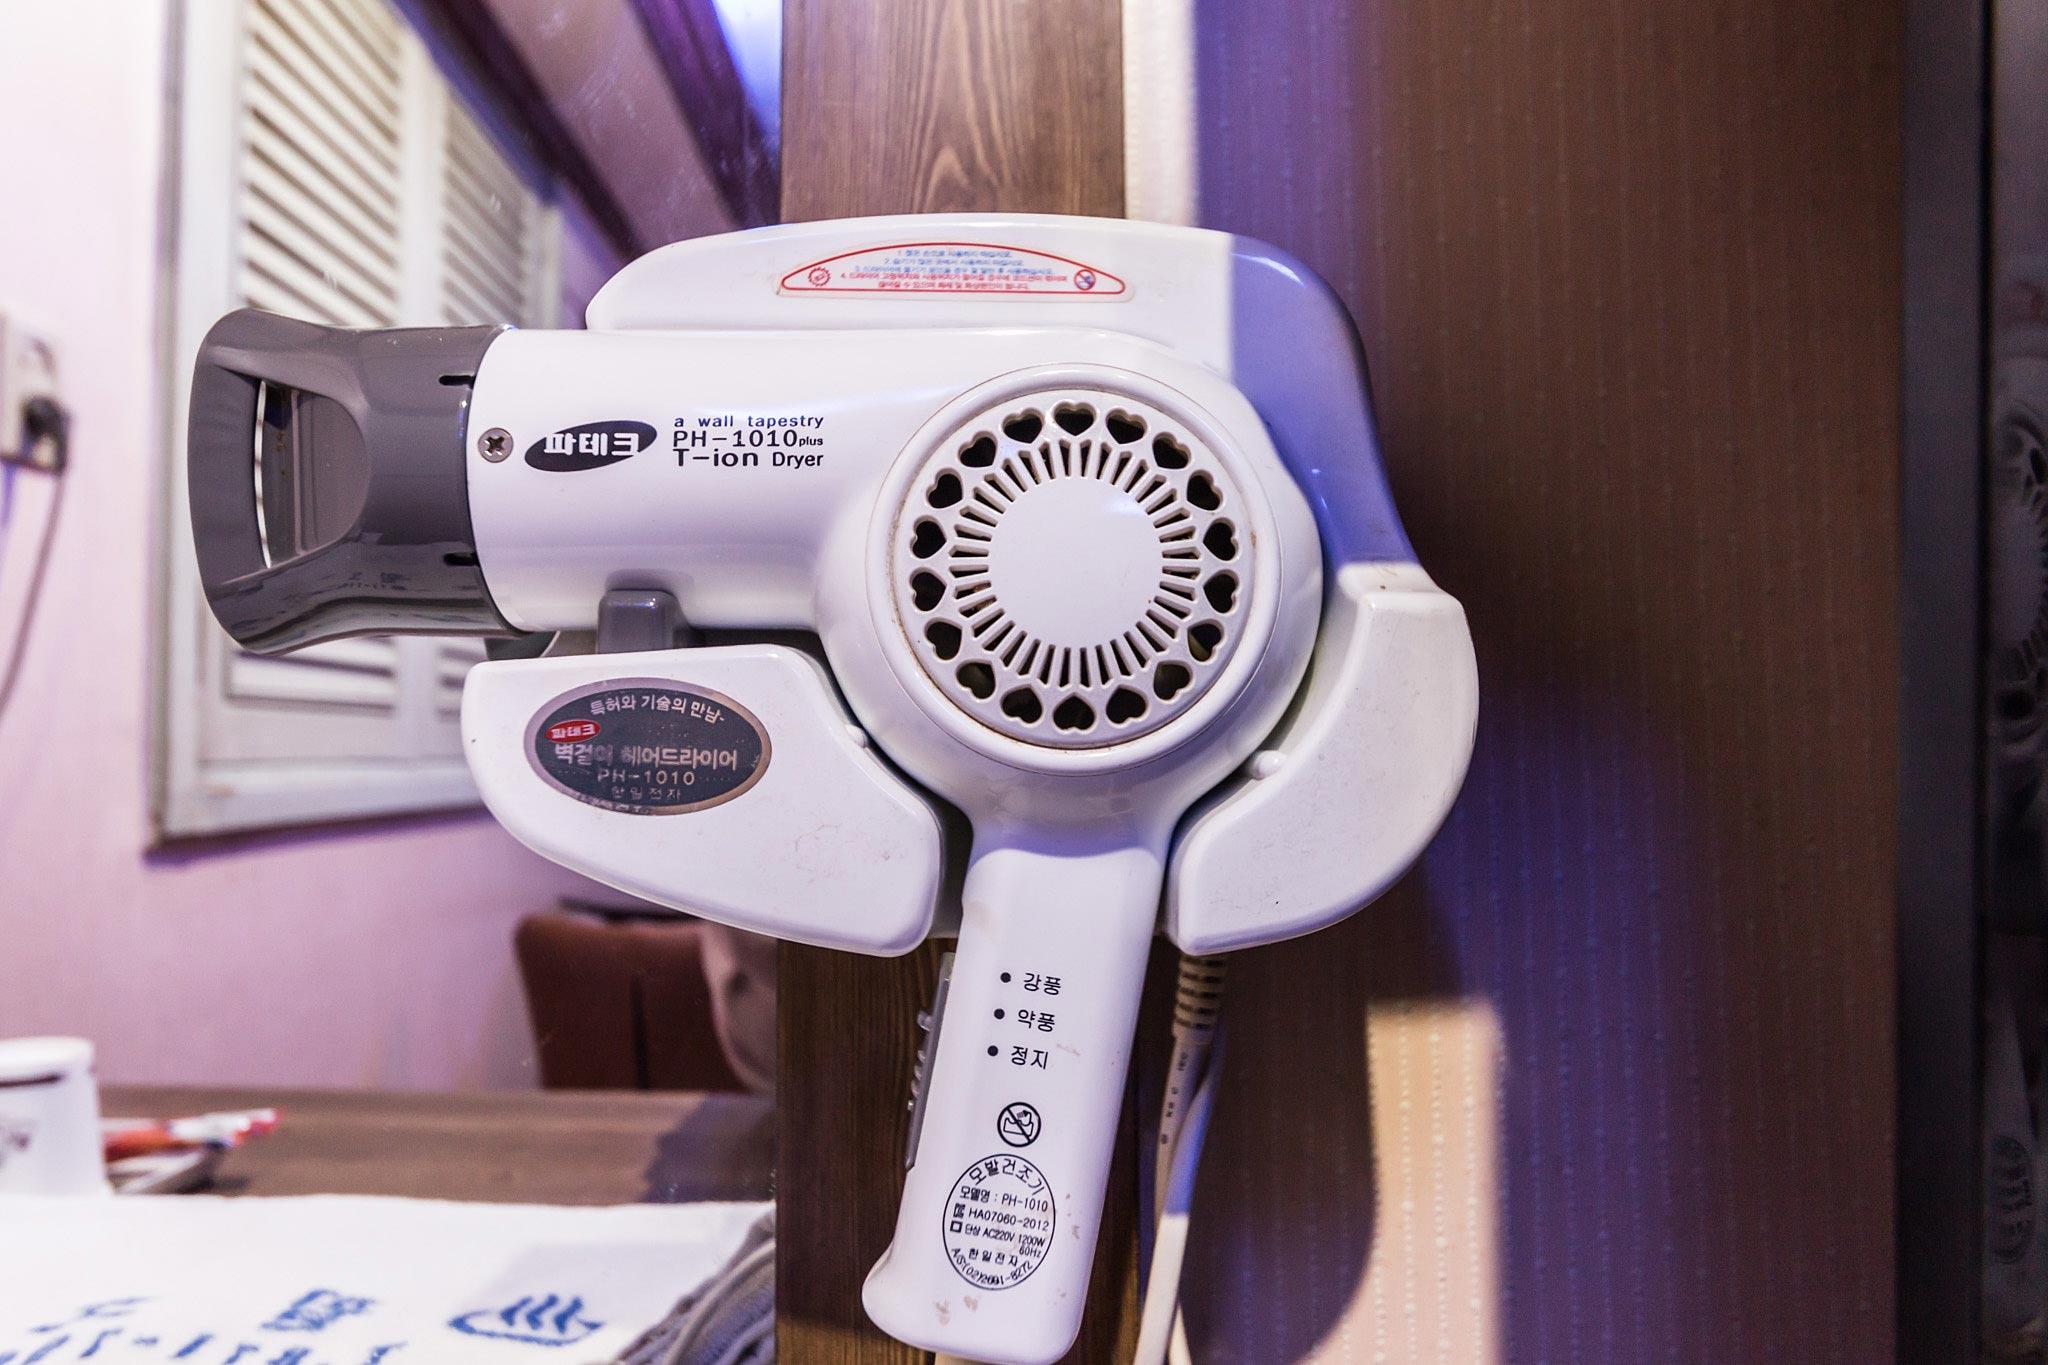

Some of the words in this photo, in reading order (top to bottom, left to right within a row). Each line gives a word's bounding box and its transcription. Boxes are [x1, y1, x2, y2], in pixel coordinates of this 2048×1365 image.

[674, 417, 684, 427] a
[698, 416, 734, 427] wall
[748, 416, 824, 429] tapestry
[544, 432, 639, 456] 파테크
[673, 449, 759, 467] T-ion
[772, 450, 824, 469] Dryer
[590, 694, 635, 716] 특허와
[641, 694, 687, 714] 기술의
[555, 744, 614, 767] 벽걸이
[622, 745, 738, 770] 헤어드라이어
[597, 769, 695, 786] PH-1010
[1023, 972, 1061, 996] 강풍
[1018, 1009, 1056, 1033] 약풍
[1011, 1045, 1049, 1070] 정지
[969, 1158, 1045, 1196] 모발건조기
[960, 1185, 991, 1203] 모델명
[1001, 1193, 1048, 1212] PH-1010
[968, 1208, 1050, 1232] HA07060-2012
[982, 1227, 1015, 1242] AC220V
[1018, 1234, 1046, 1247] 1200W
[1019, 1244, 1042, 1258] 60Hz
